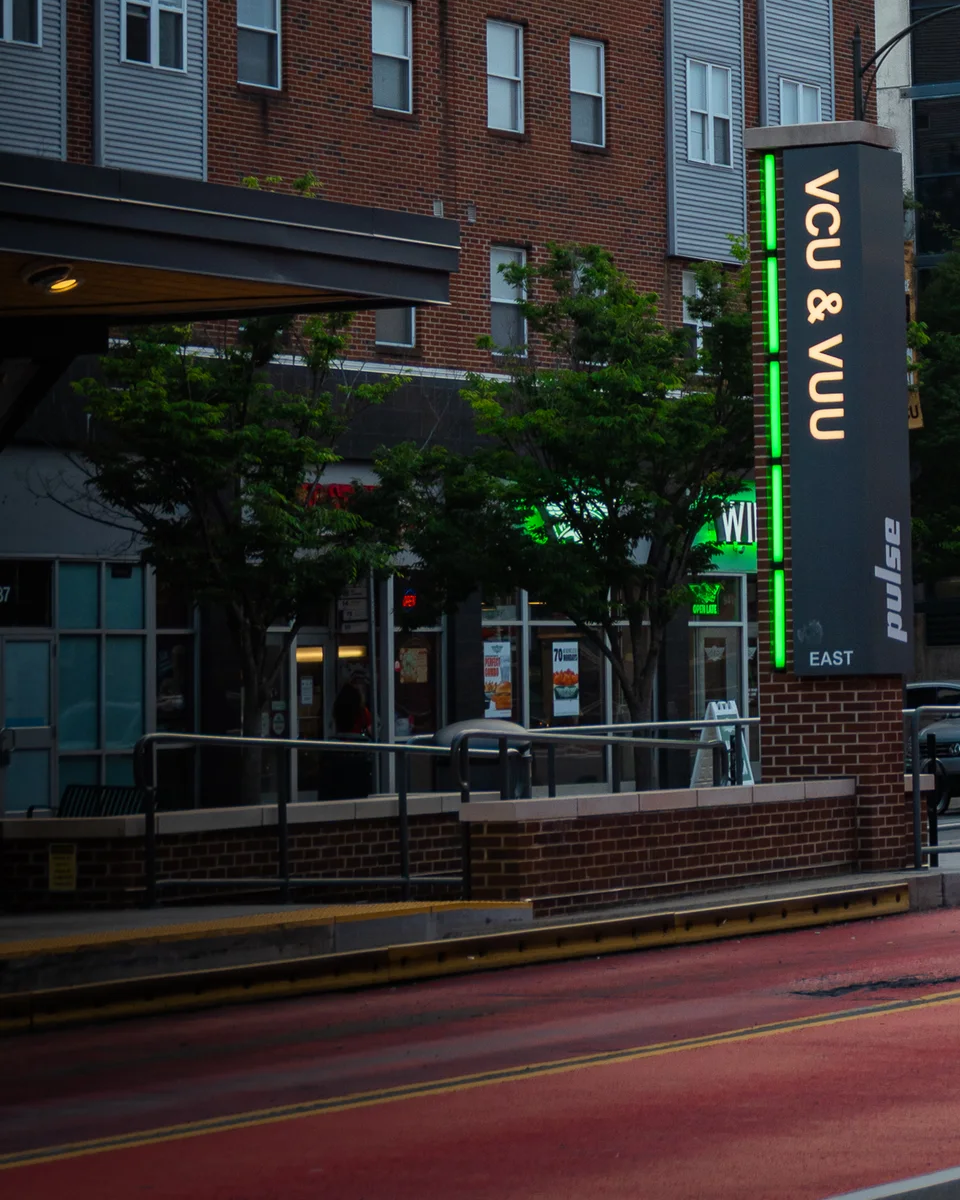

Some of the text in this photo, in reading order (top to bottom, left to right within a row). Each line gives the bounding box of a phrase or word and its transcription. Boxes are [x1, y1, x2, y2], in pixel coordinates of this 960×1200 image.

[804, 168, 845, 440] VCU & VUU
[874, 516, 908, 643] pulse
[692, 603, 706, 615] OPEN
[553, 648, 563, 662] 70
[809, 650, 853, 666] EAST
